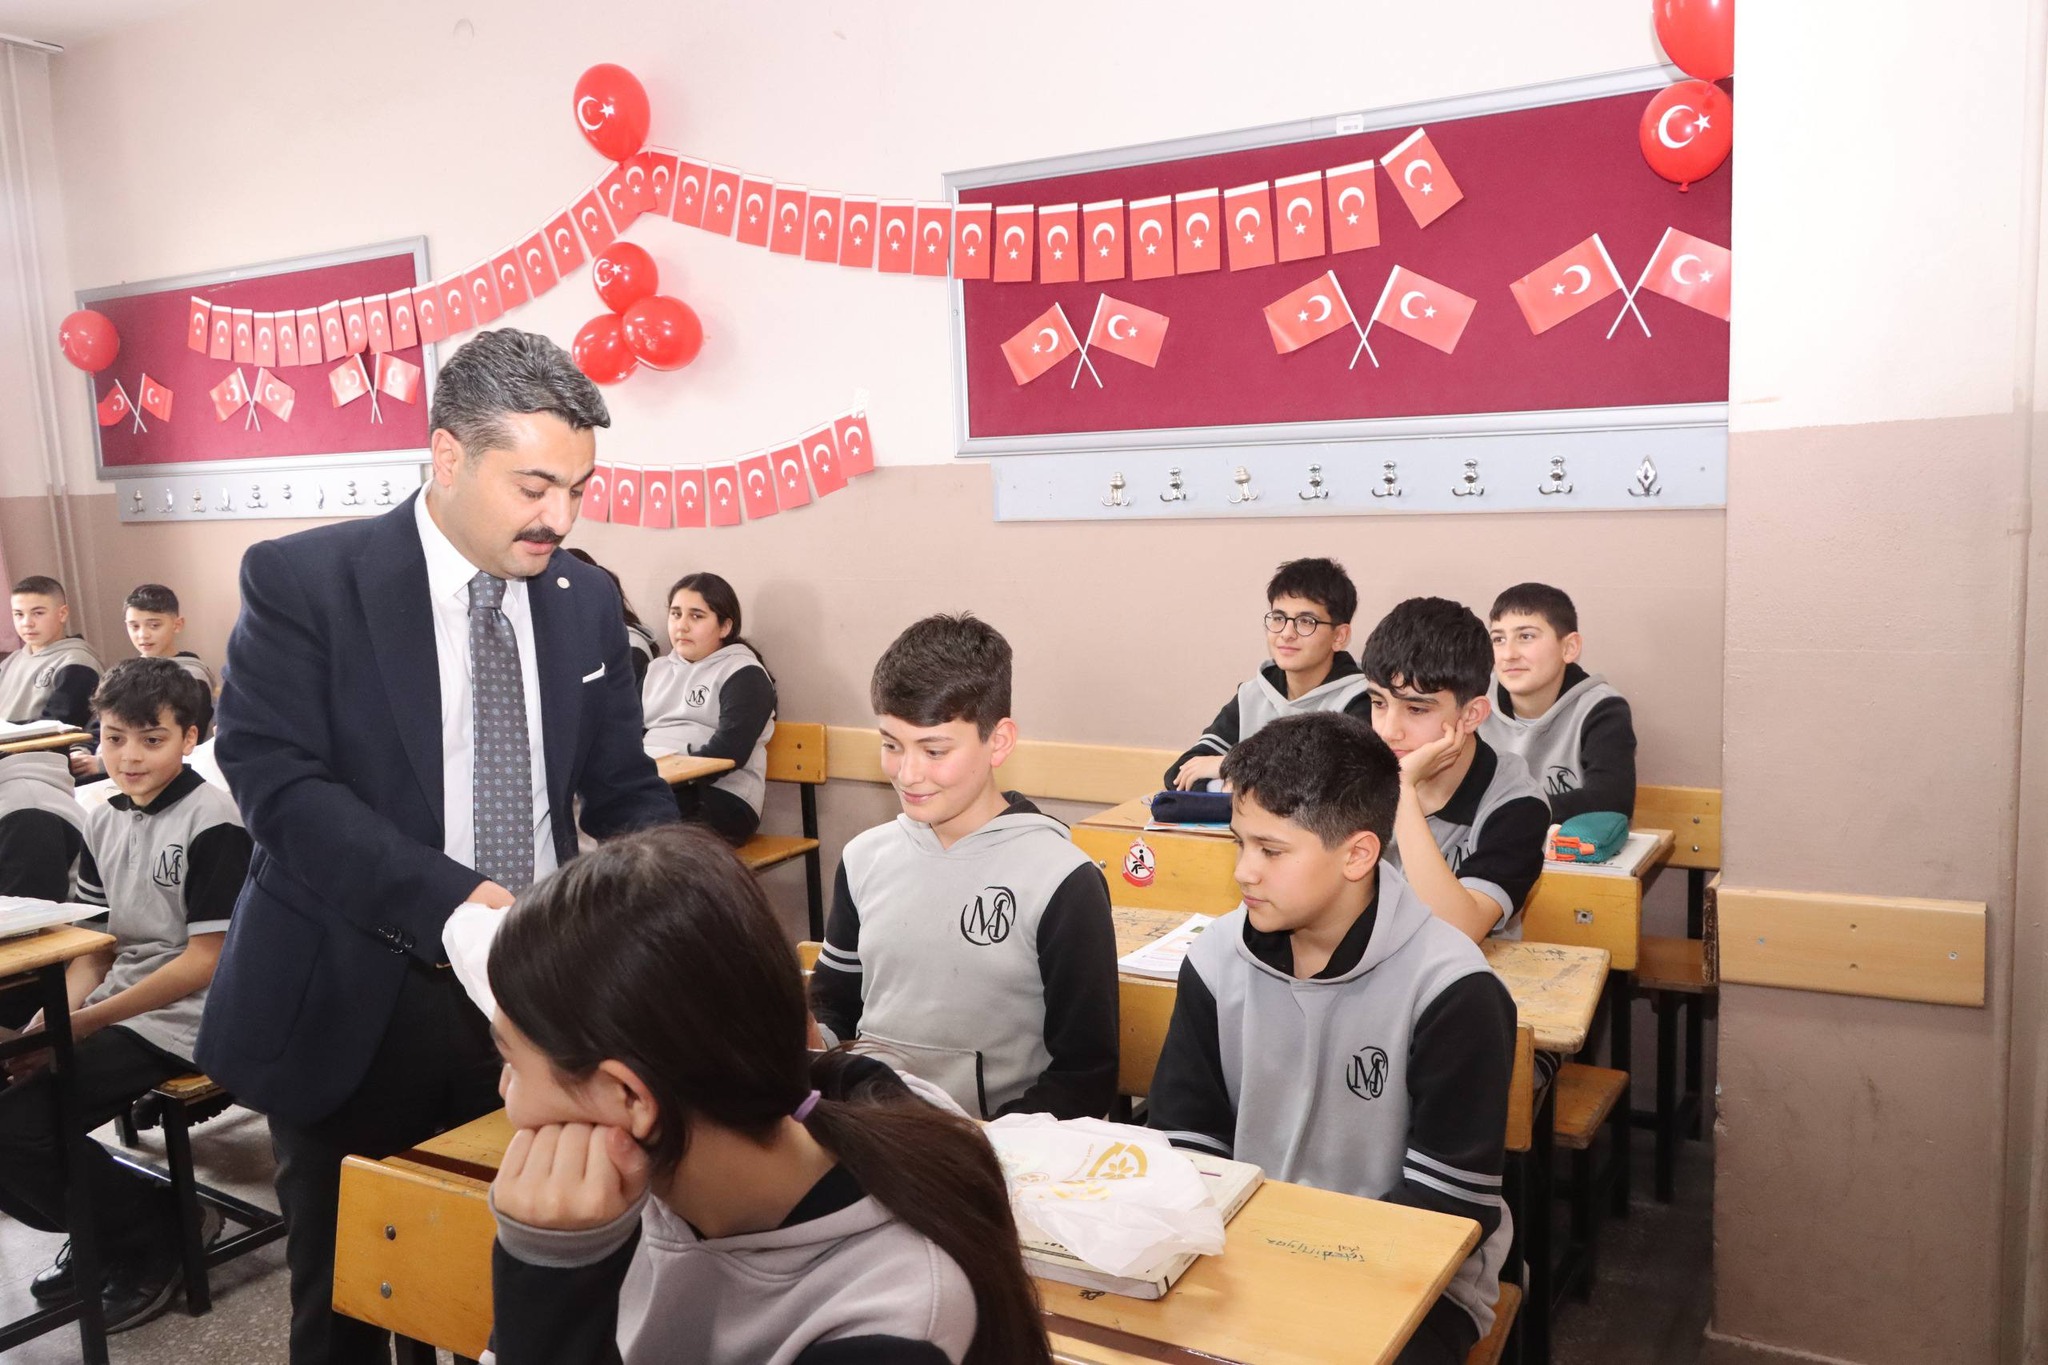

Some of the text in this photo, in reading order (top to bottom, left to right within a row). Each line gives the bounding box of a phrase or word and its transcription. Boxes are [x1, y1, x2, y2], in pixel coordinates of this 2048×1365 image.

[687, 686, 707, 706] MS
[963, 889, 1013, 944] MS
[1348, 1050, 1386, 1099] MS
